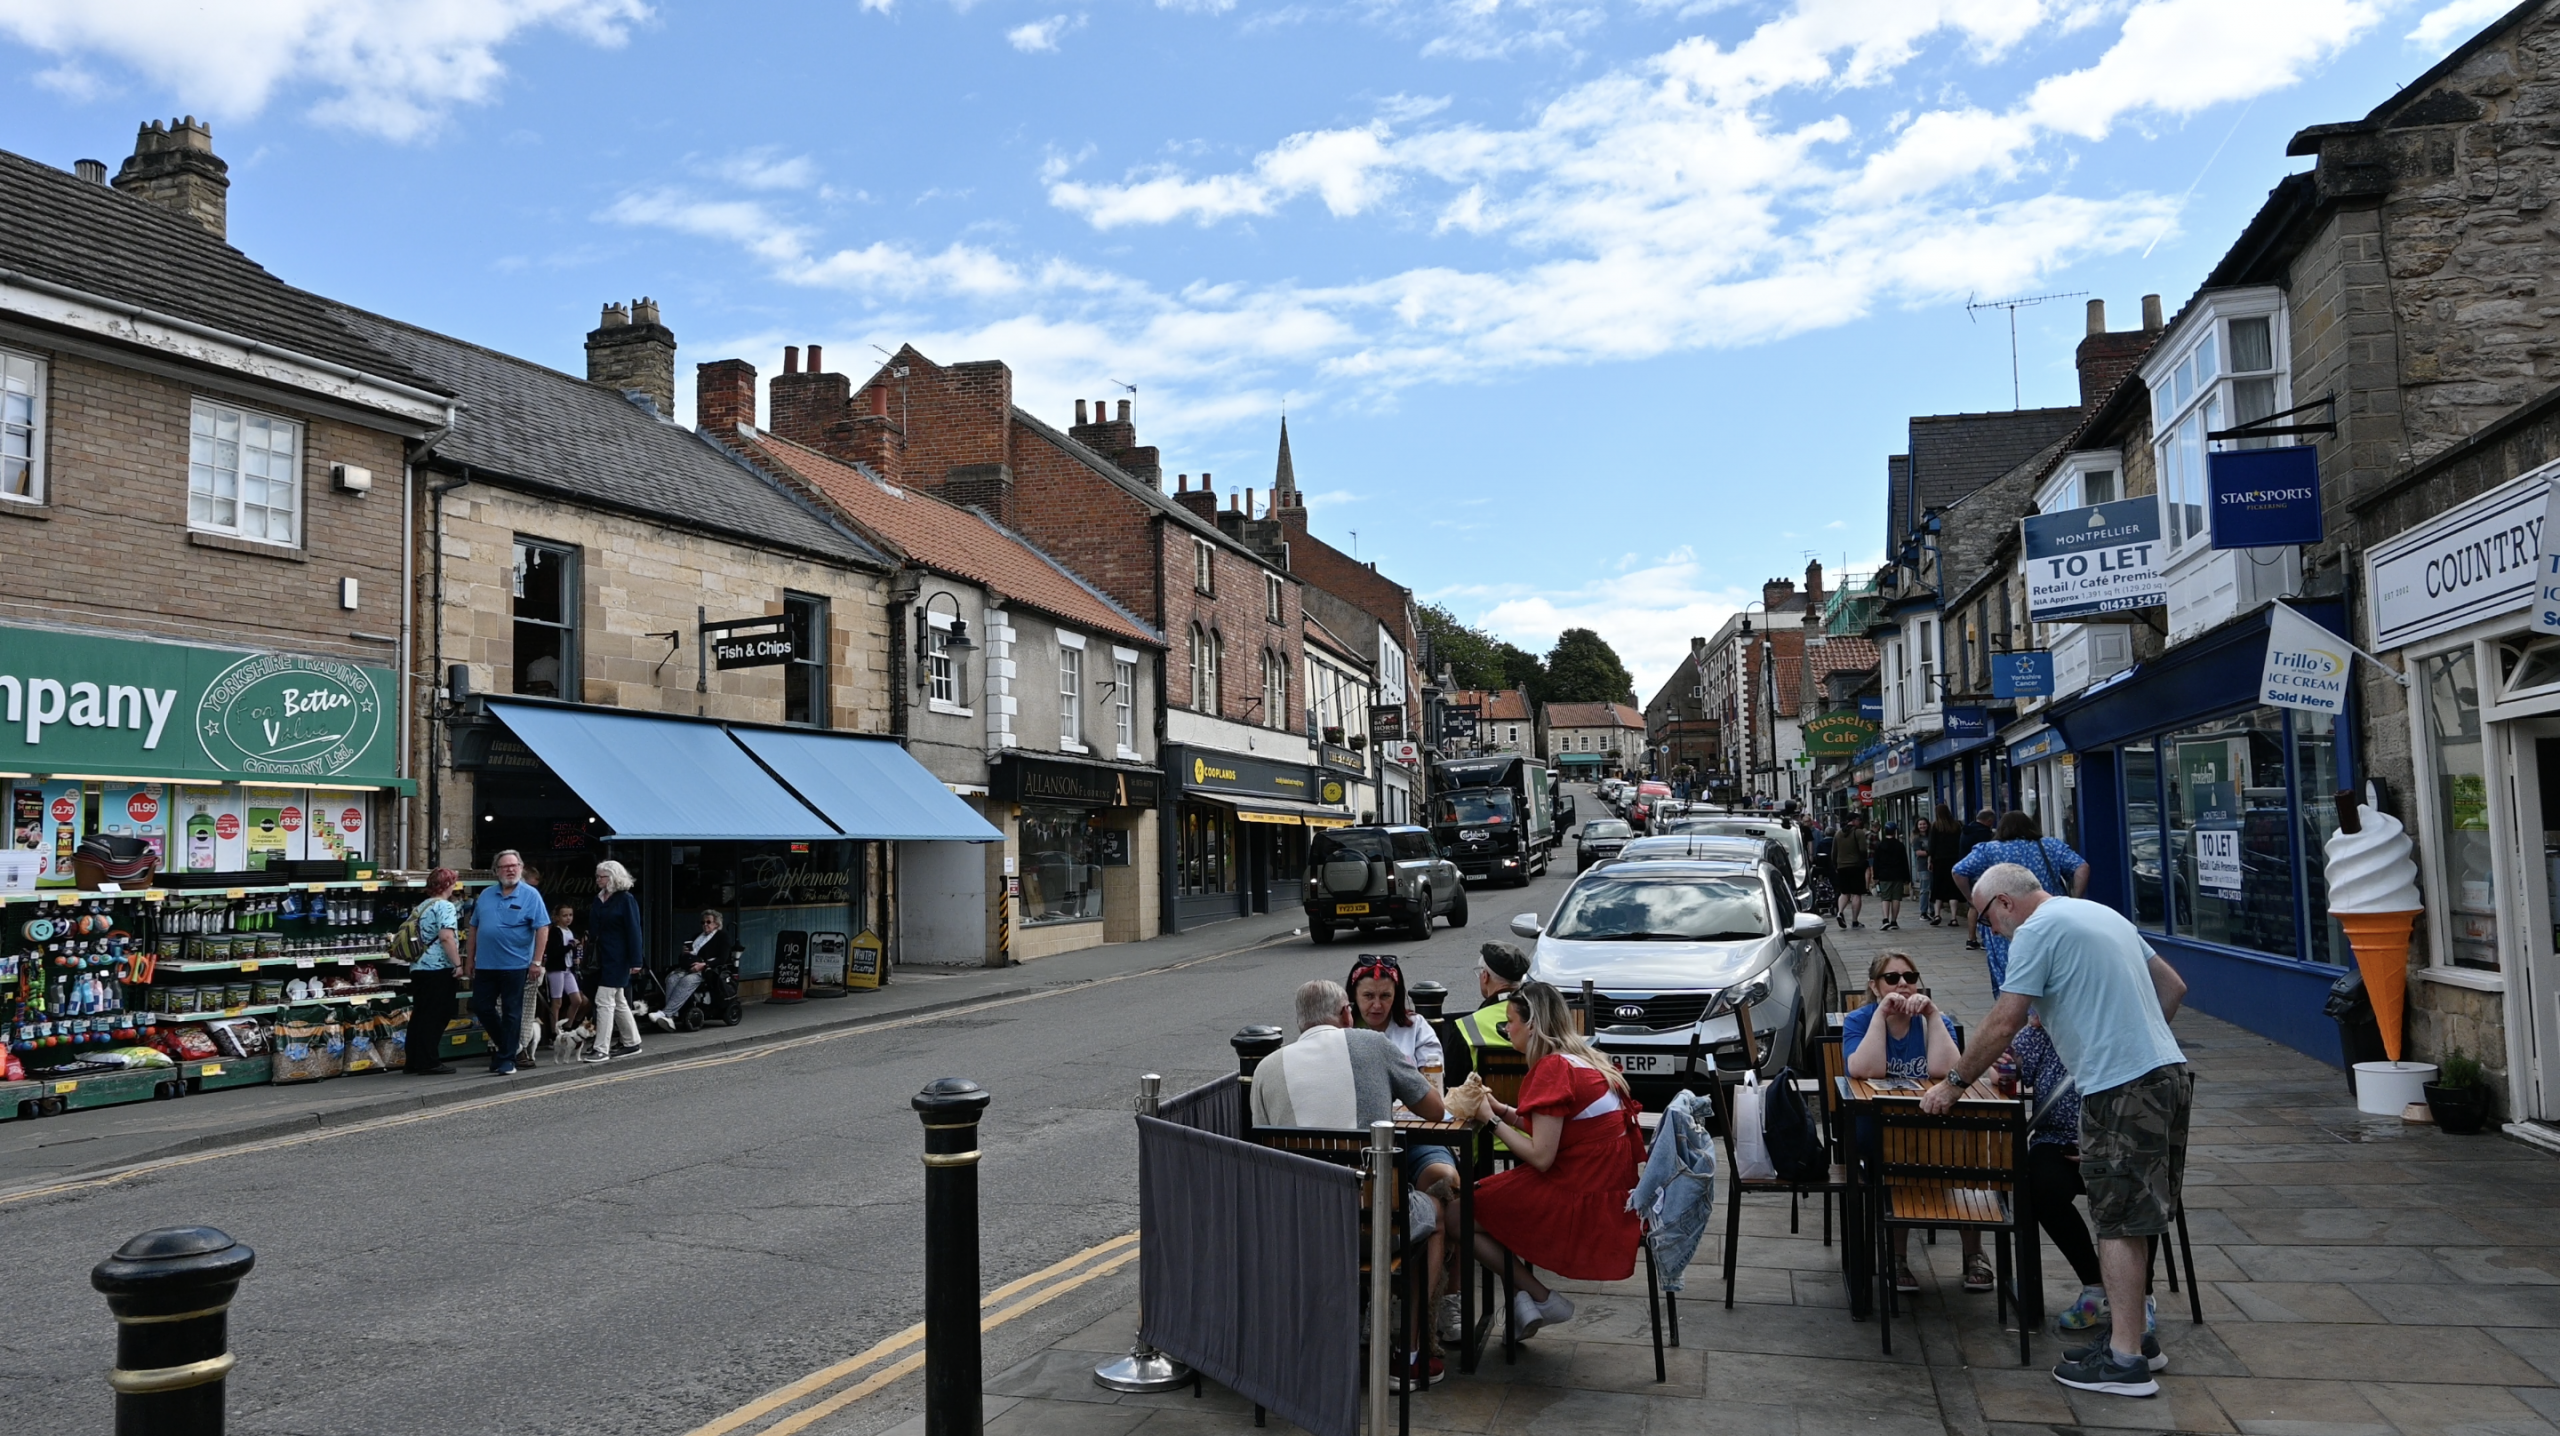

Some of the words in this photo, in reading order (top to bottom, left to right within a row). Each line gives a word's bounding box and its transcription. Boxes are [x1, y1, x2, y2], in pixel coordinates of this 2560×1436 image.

[2220, 491, 2254, 505] STAR
[2259, 487, 2312, 501] SPORTS
[2246, 502, 2288, 511] PICKERING
[2056, 524, 2140, 546] MONTPELLIER
[2048, 554, 2088, 580] TO
[2099, 544, 2153, 572] LET
[2426, 515, 2544, 599] COUNTRY
[2033, 581, 2069, 596] Retail
[2071, 580, 2077, 591] /
[2080, 576, 2109, 589] Café
[2113, 570, 2161, 584] Premis
[2033, 598, 2048, 606] NIA
[2049, 594, 2080, 604] Approx
[2081, 590, 2102, 600] 1,391
[2122, 583, 2152, 594] (129.20
[2384, 590, 2394, 602] EST
[2099, 597, 2134, 612] 01423
[717, 643, 744, 660] Fish
[745, 643, 755, 656] &
[756, 639, 792, 660] Chips
[2273, 650, 2332, 673] Trillo's
[203, 655, 292, 713] YORKSHIRE
[2268, 672, 2290, 685] ICE
[2292, 676, 2340, 692] CREAM
[282, 688, 352, 718] Better
[2267, 689, 2299, 703] Sold
[2300, 694, 2335, 708] Here
[1807, 715, 1875, 734] Russell's
[1822, 730, 1859, 743] Cafe
[243, 757, 325, 776] COMPANY
[1204, 766, 1237, 781] COOPLANDS
[1025, 772, 1079, 796] ALLANSON
[1079, 785, 1111, 799] FLOORING
[52, 805, 75, 814] £2.79
[129, 803, 157, 813] £11.99
[280, 817, 302, 826] £9.99
[342, 819, 362, 827] £6.99
[58, 838, 72, 846] ANT
[1459, 829, 1490, 842] Carlsberg
[2202, 834, 2214, 857] TO
[2215, 834, 2231, 857] LET
[753, 854, 850, 899] Capplemans
[1619, 1006, 1641, 1018] KIA
[1625, 1055, 1657, 1071] ERP
